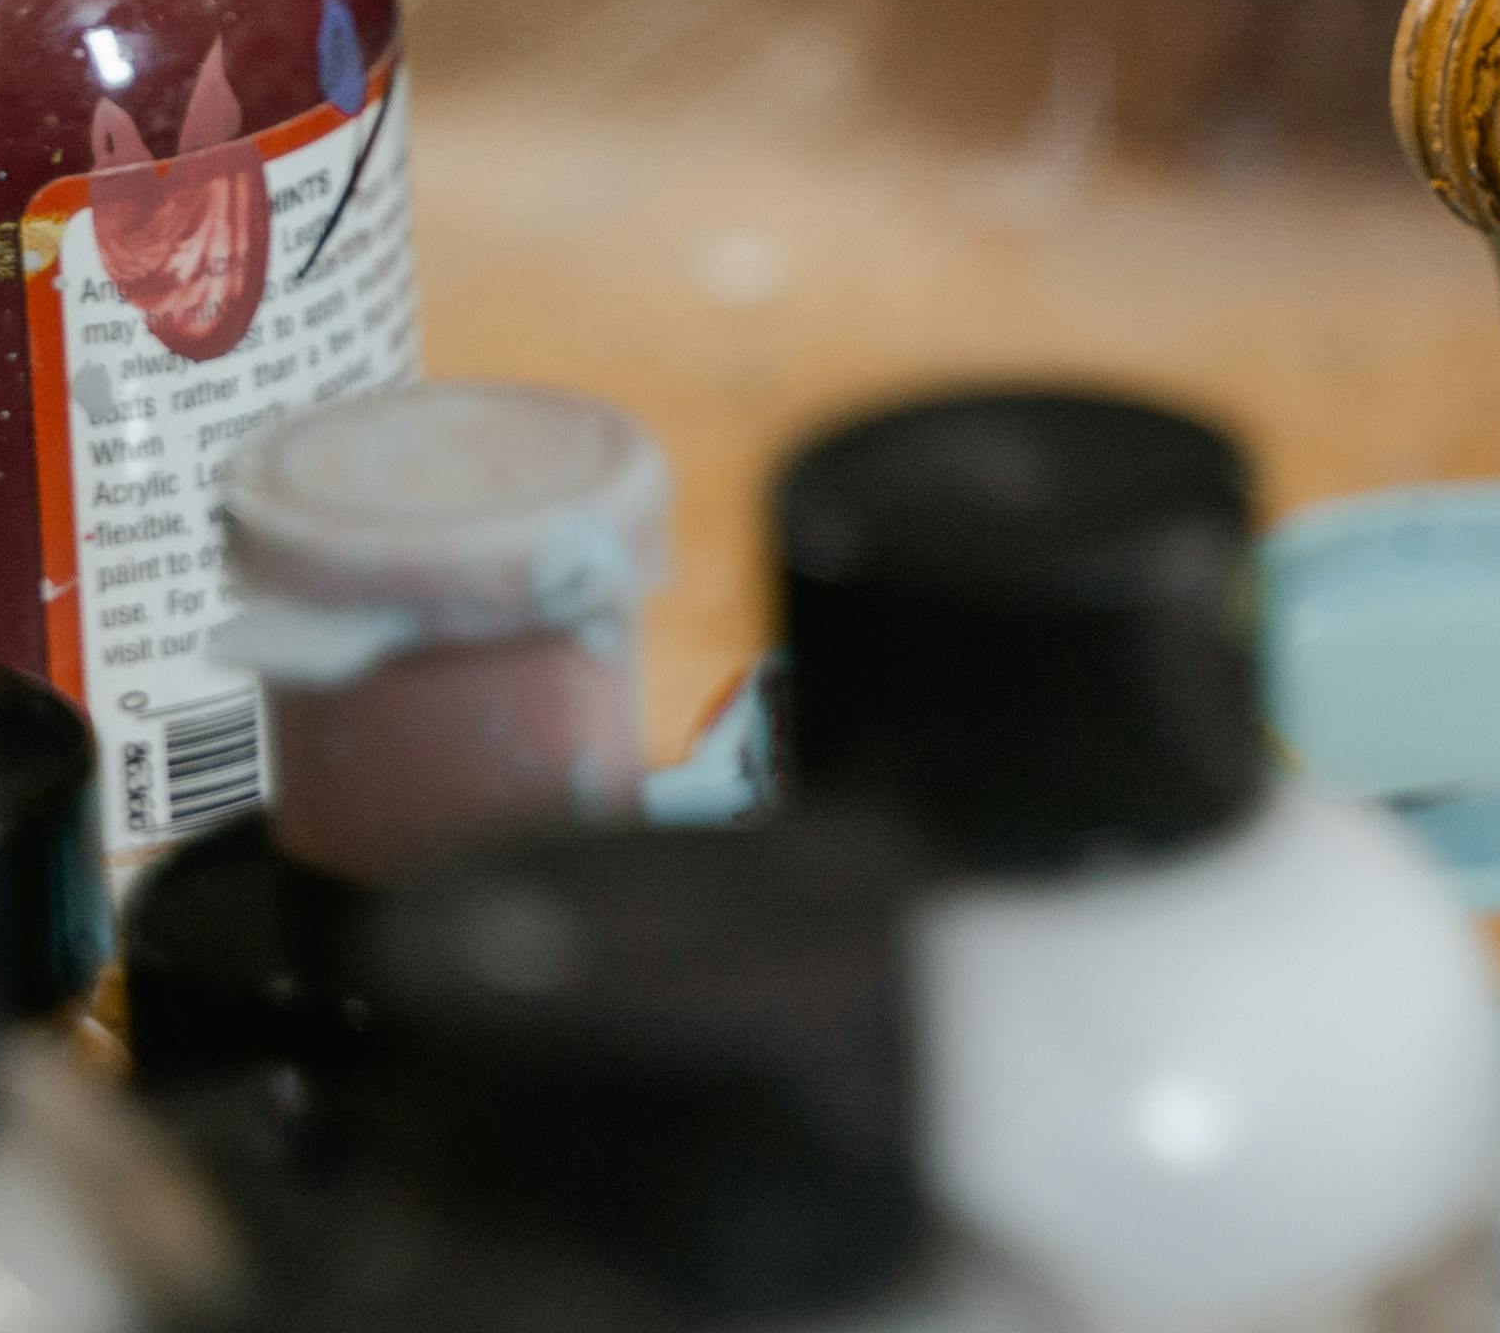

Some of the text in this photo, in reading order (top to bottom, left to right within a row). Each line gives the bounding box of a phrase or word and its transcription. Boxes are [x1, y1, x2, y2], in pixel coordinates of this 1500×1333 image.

[88, 433, 168, 467] When
[92, 470, 181, 508] Acrylic
[96, 555, 162, 594] paint
